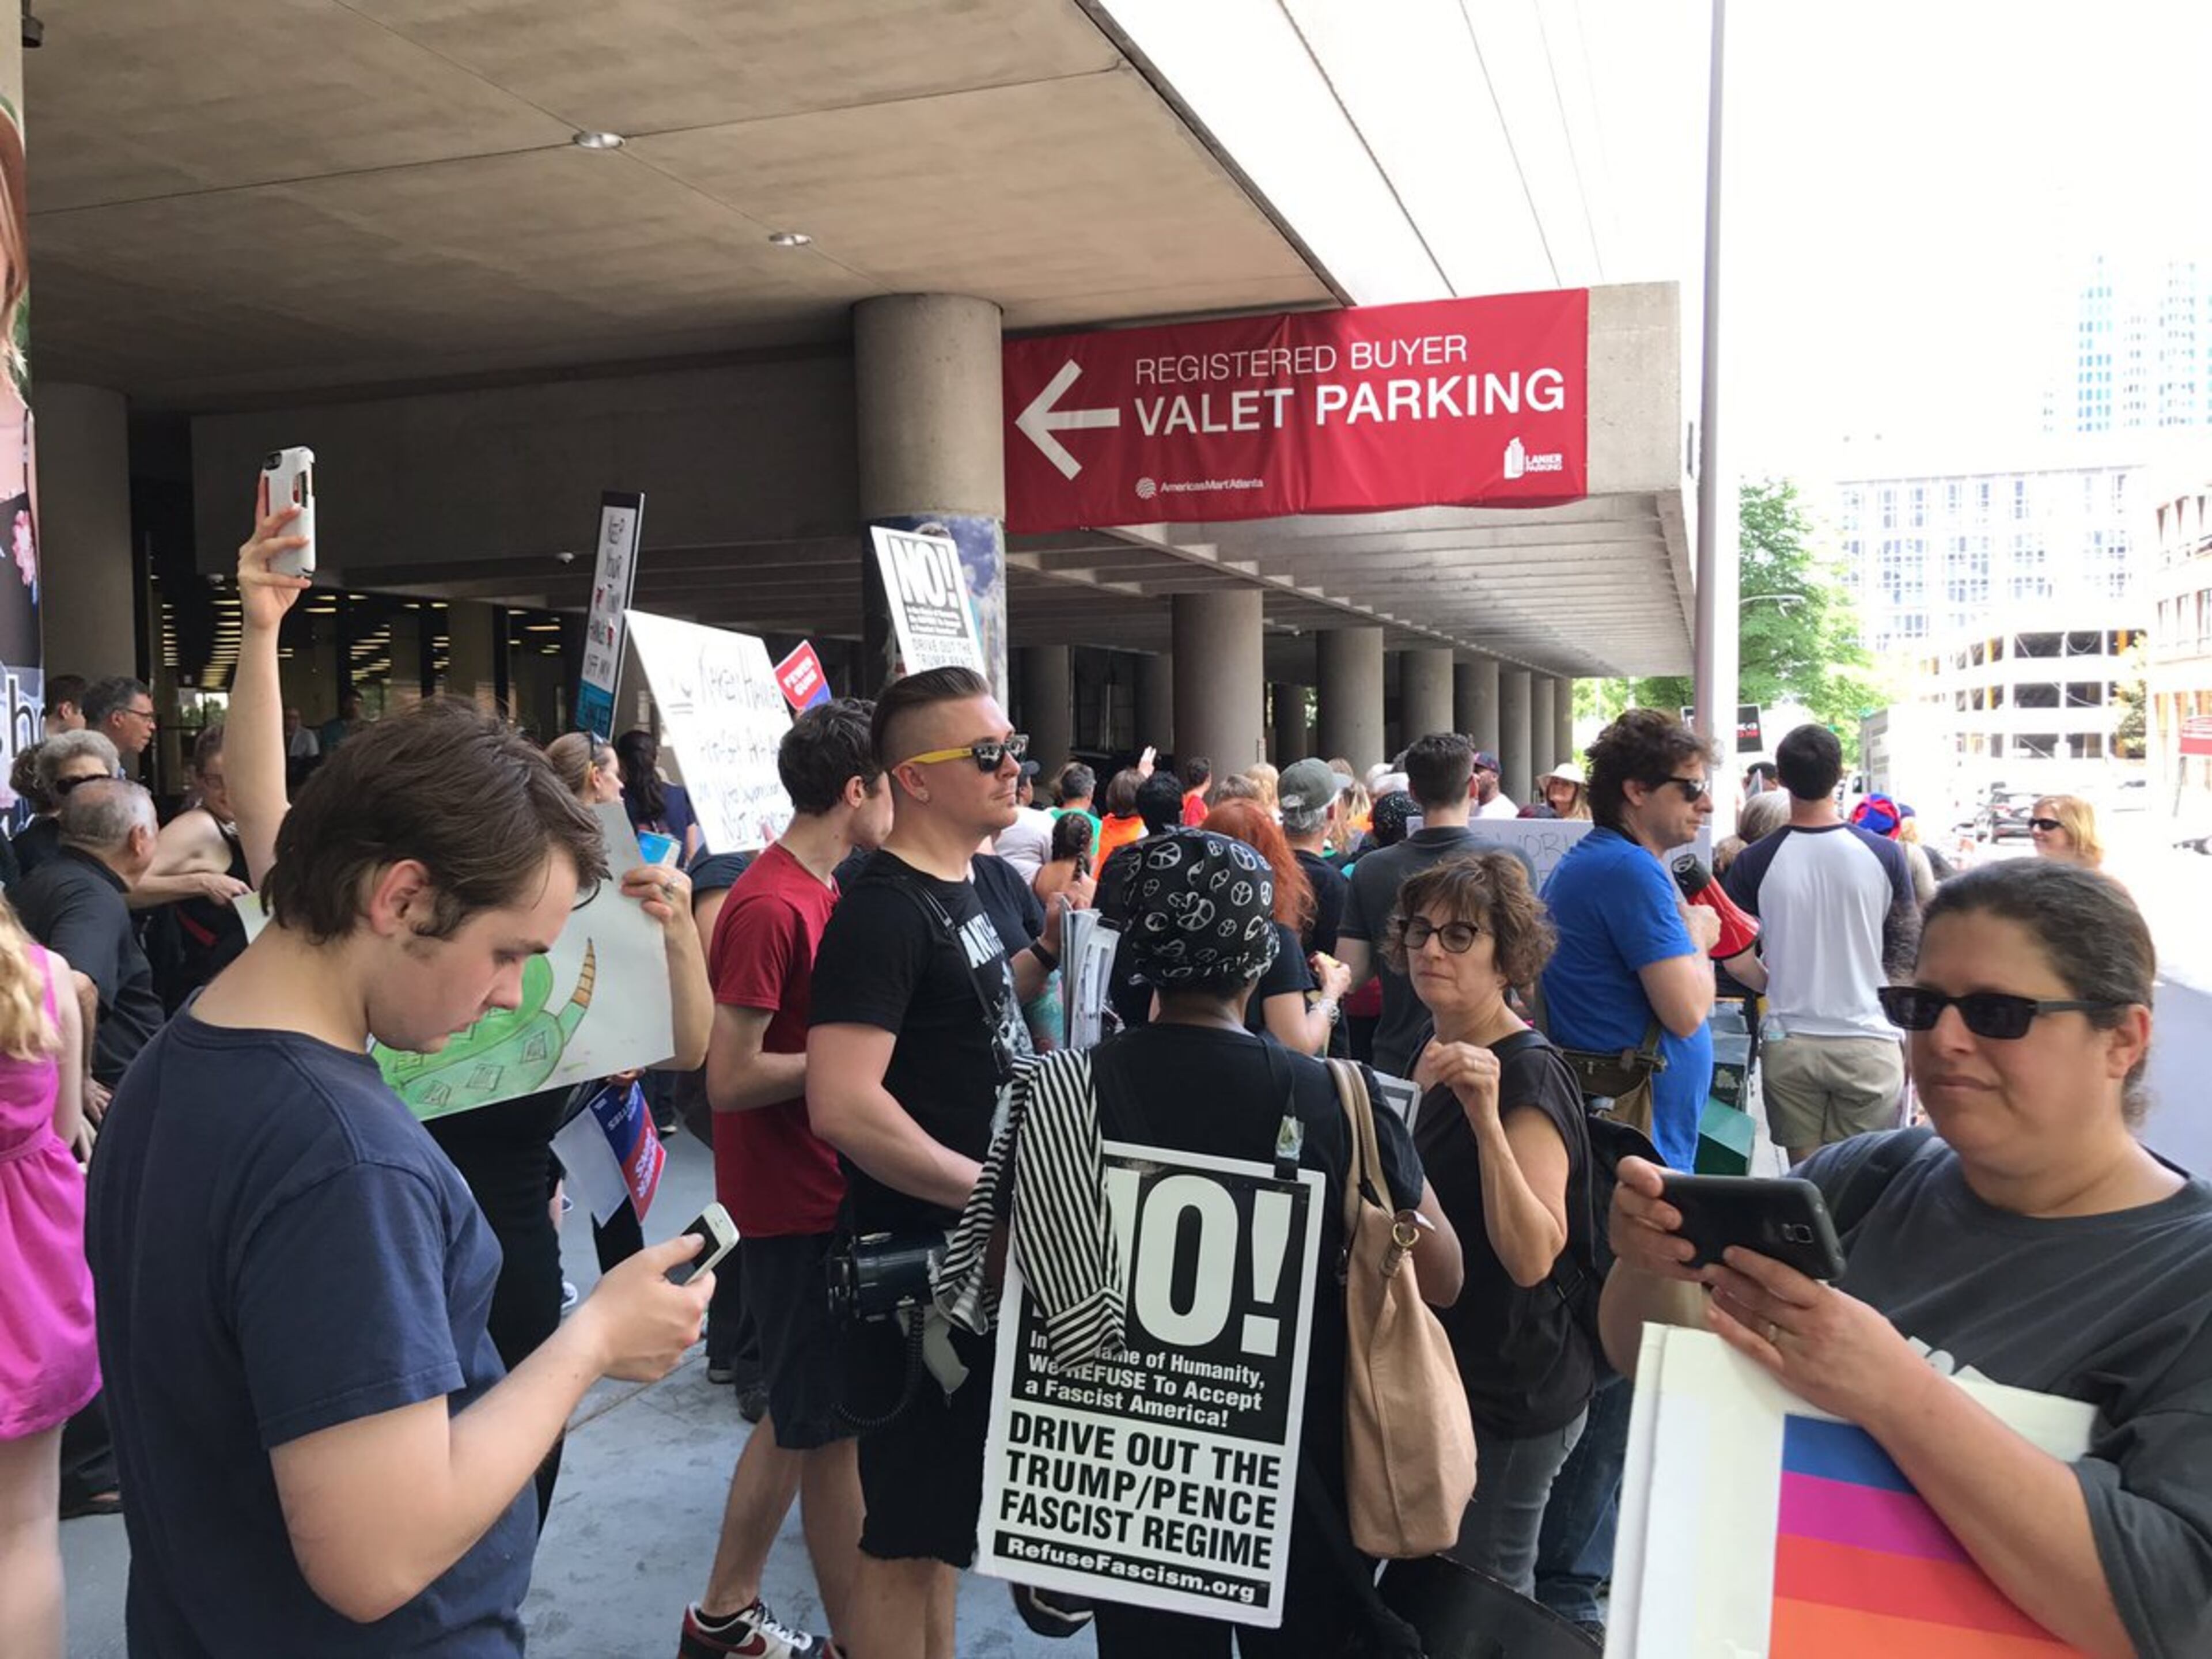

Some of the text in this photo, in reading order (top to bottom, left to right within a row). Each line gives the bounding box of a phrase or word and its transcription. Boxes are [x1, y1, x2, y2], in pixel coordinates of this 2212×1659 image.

[1136, 335, 1467, 385] REGISTERED BUYER
[1134, 368, 1565, 436] VALET PARKING
[889, 537, 960, 608] NO!
[1028, 1353, 1059, 1376] We
[1153, 1375, 1177, 1396] To
[1183, 1381, 1263, 1411] Accept
[1029, 1330, 1048, 1350] In
[1145, 1351, 1166, 1369] of
[1170, 1353, 1266, 1389] Humanity,
[1025, 1379, 1229, 1428] a Fascist America!
[1008, 1410, 1282, 1490] DRIVE OUT THE
[1006, 1448, 1278, 1531] TRUMP/PENCE
[999, 1487, 1273, 1570] FASCIST REGIME
[1007, 1536, 1256, 1604] RefuseFascism.org
